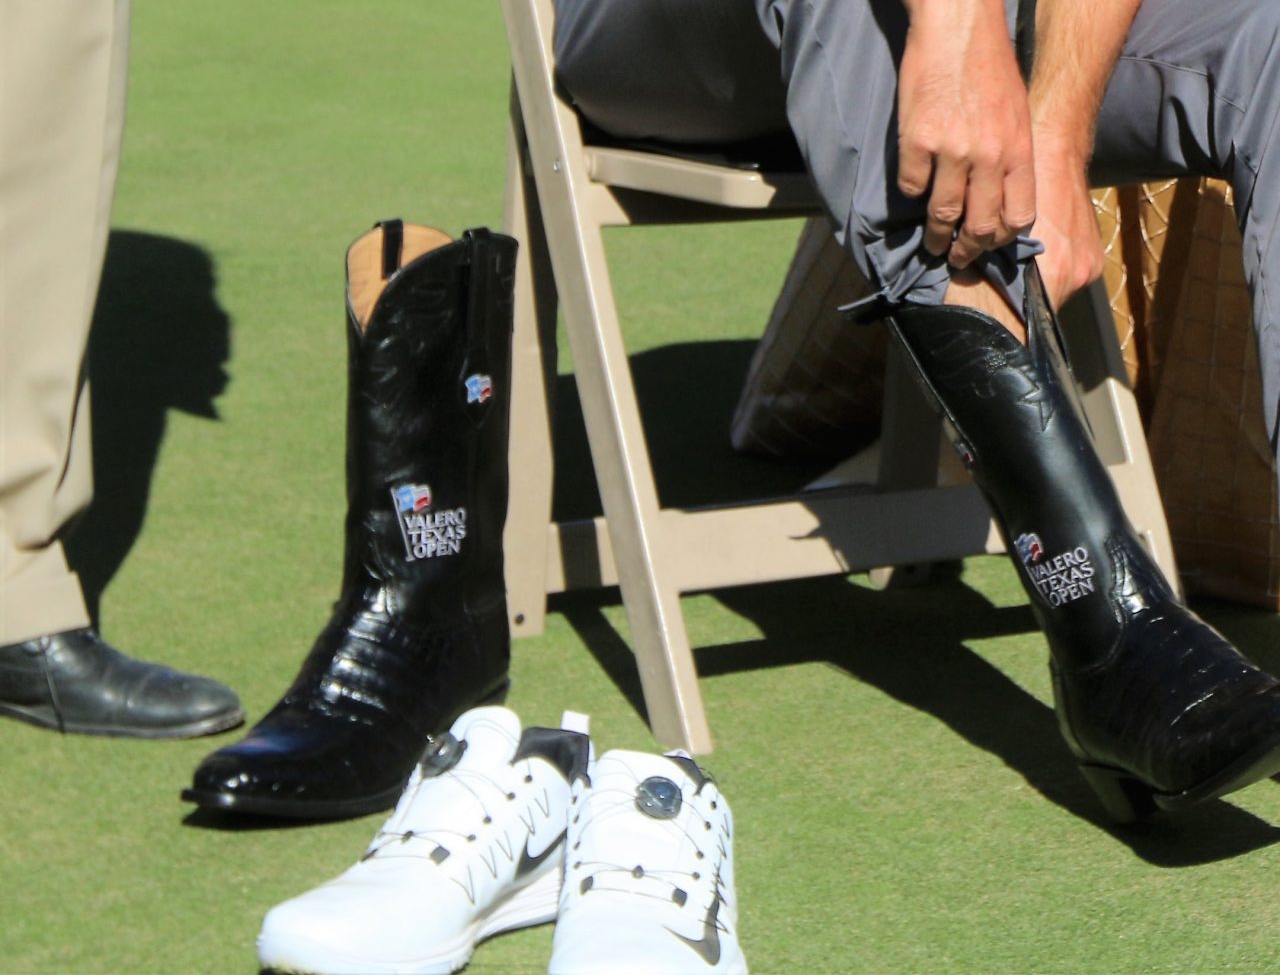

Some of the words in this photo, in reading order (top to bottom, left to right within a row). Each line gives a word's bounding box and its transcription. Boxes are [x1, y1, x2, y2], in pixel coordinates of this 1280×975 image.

[404, 507, 467, 530] VALERO
[407, 525, 467, 546] TEXAS
[413, 539, 462, 559] OPEN
[1030, 546, 1089, 581] VALERO
[1036, 561, 1095, 594] TEXAS
[1048, 577, 1095, 607] OPEN
